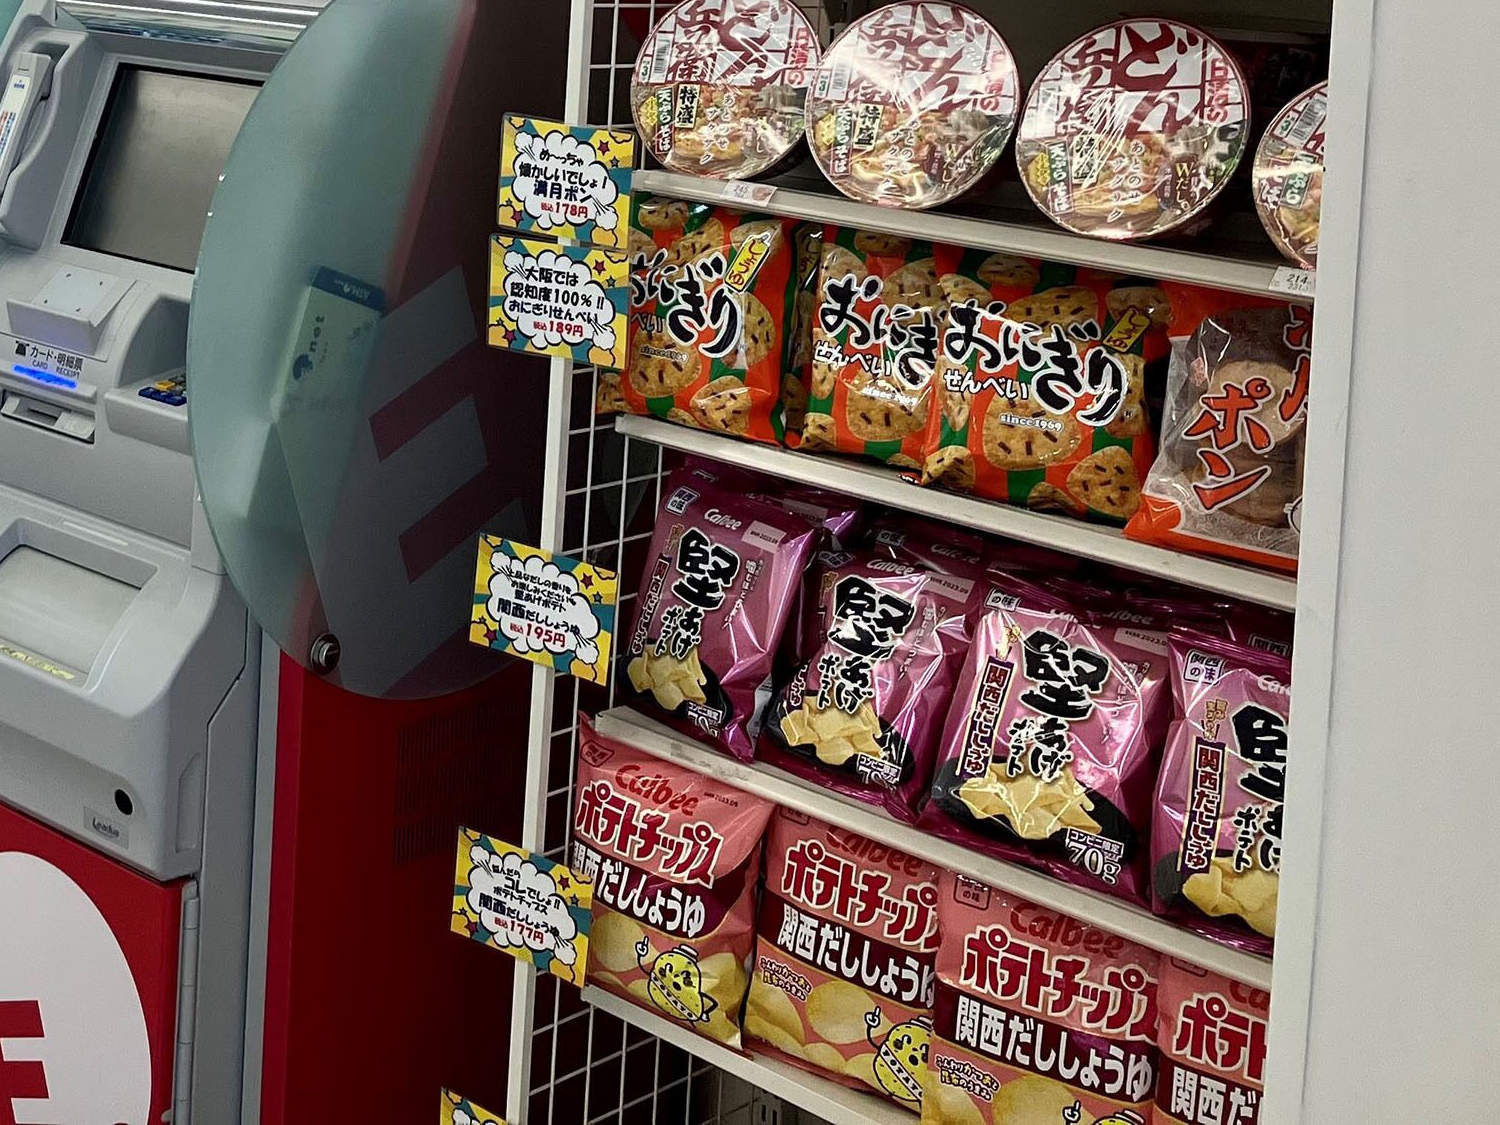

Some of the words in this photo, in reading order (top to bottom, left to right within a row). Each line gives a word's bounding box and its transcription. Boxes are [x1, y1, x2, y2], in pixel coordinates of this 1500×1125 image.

[676, 85, 697, 128] 特盛
[856, 106, 881, 149] 特盛
[533, 180, 593, 203] 満月ポン
[525, 266, 579, 287] 大阪では
[509, 299, 598, 325] おにぎりせんべい
[32, 360, 48, 370] CARD
[813, 338, 894, 377] せんべい
[942, 297, 1129, 427] おにぎり
[944, 368, 1030, 401] せんべい
[704, 508, 743, 532] Calbee
[497, 597, 581, 636] 関西だししょうゆ
[615, 763, 699, 817] Calbee
[574, 780, 724, 890] ポテトチップス
[825, 825, 924, 877] Calbee
[1068, 841, 1123, 885] 70g
[493, 885, 549, 916] ポテトチップス
[572, 840, 706, 938] 関西だししょうゆ
[478, 892, 560, 937] 関西だししょうゆ
[1010, 902, 1125, 960] Calbee
[955, 995, 1153, 1104] 関西だししょうゆ
